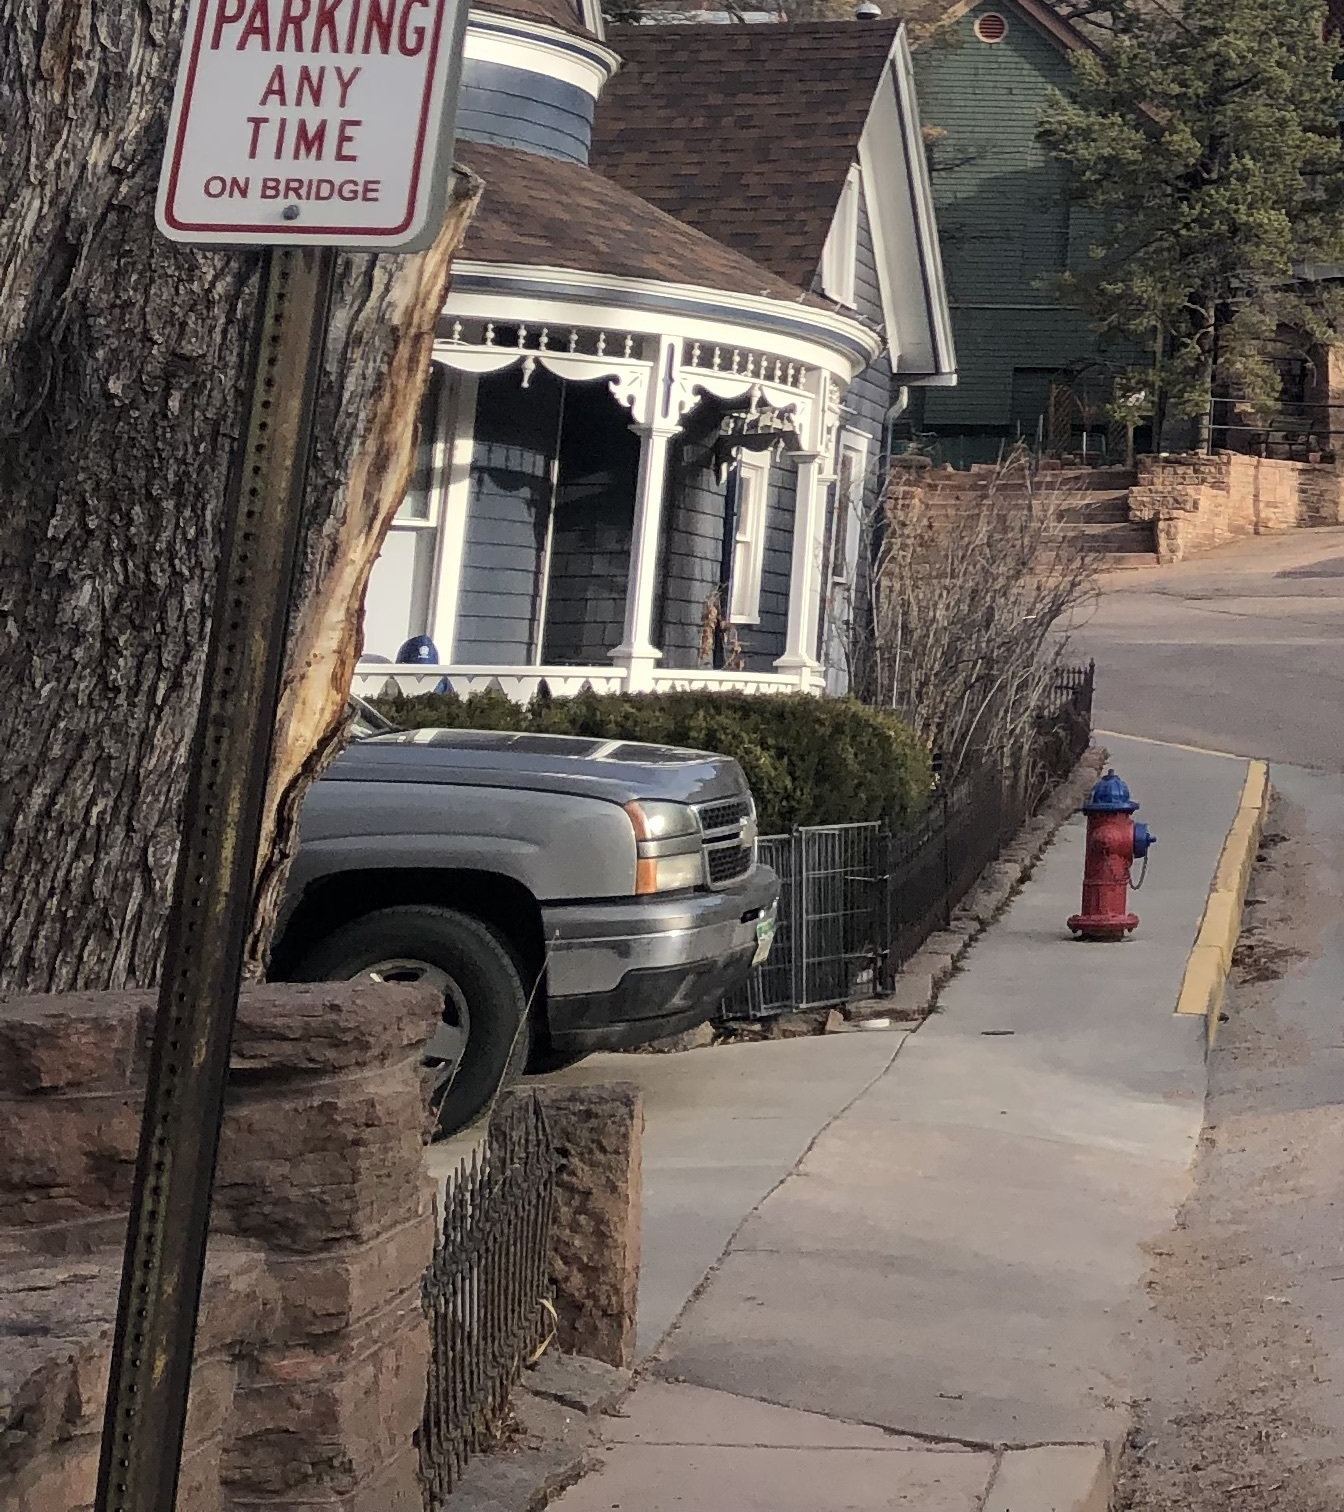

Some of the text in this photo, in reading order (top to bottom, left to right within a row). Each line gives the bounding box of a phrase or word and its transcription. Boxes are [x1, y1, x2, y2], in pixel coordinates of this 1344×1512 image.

[259, 65, 361, 108] ANY
[246, 116, 363, 162] TIME
[203, 175, 381, 203] ON BRIDGE
